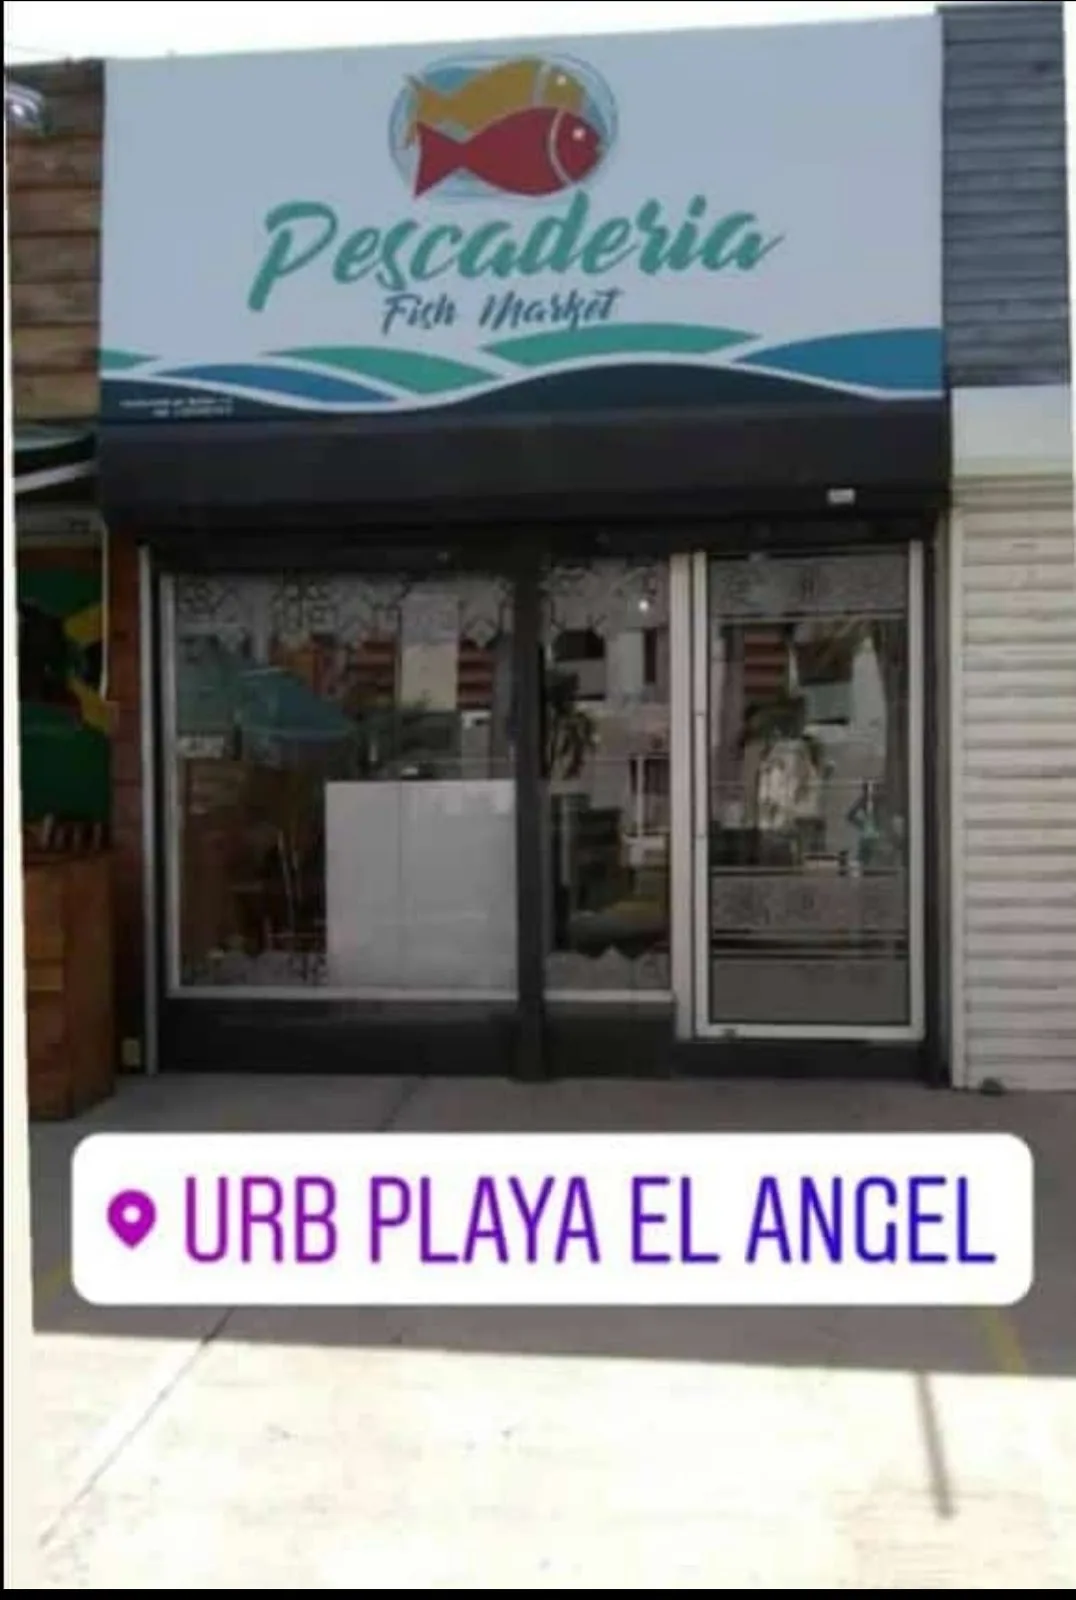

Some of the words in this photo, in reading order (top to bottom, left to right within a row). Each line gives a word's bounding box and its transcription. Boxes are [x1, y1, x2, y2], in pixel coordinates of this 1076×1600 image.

[248, 191, 784, 311] Pescaderia
[382, 290, 456, 335] Fish
[480, 286, 621, 333] Market
